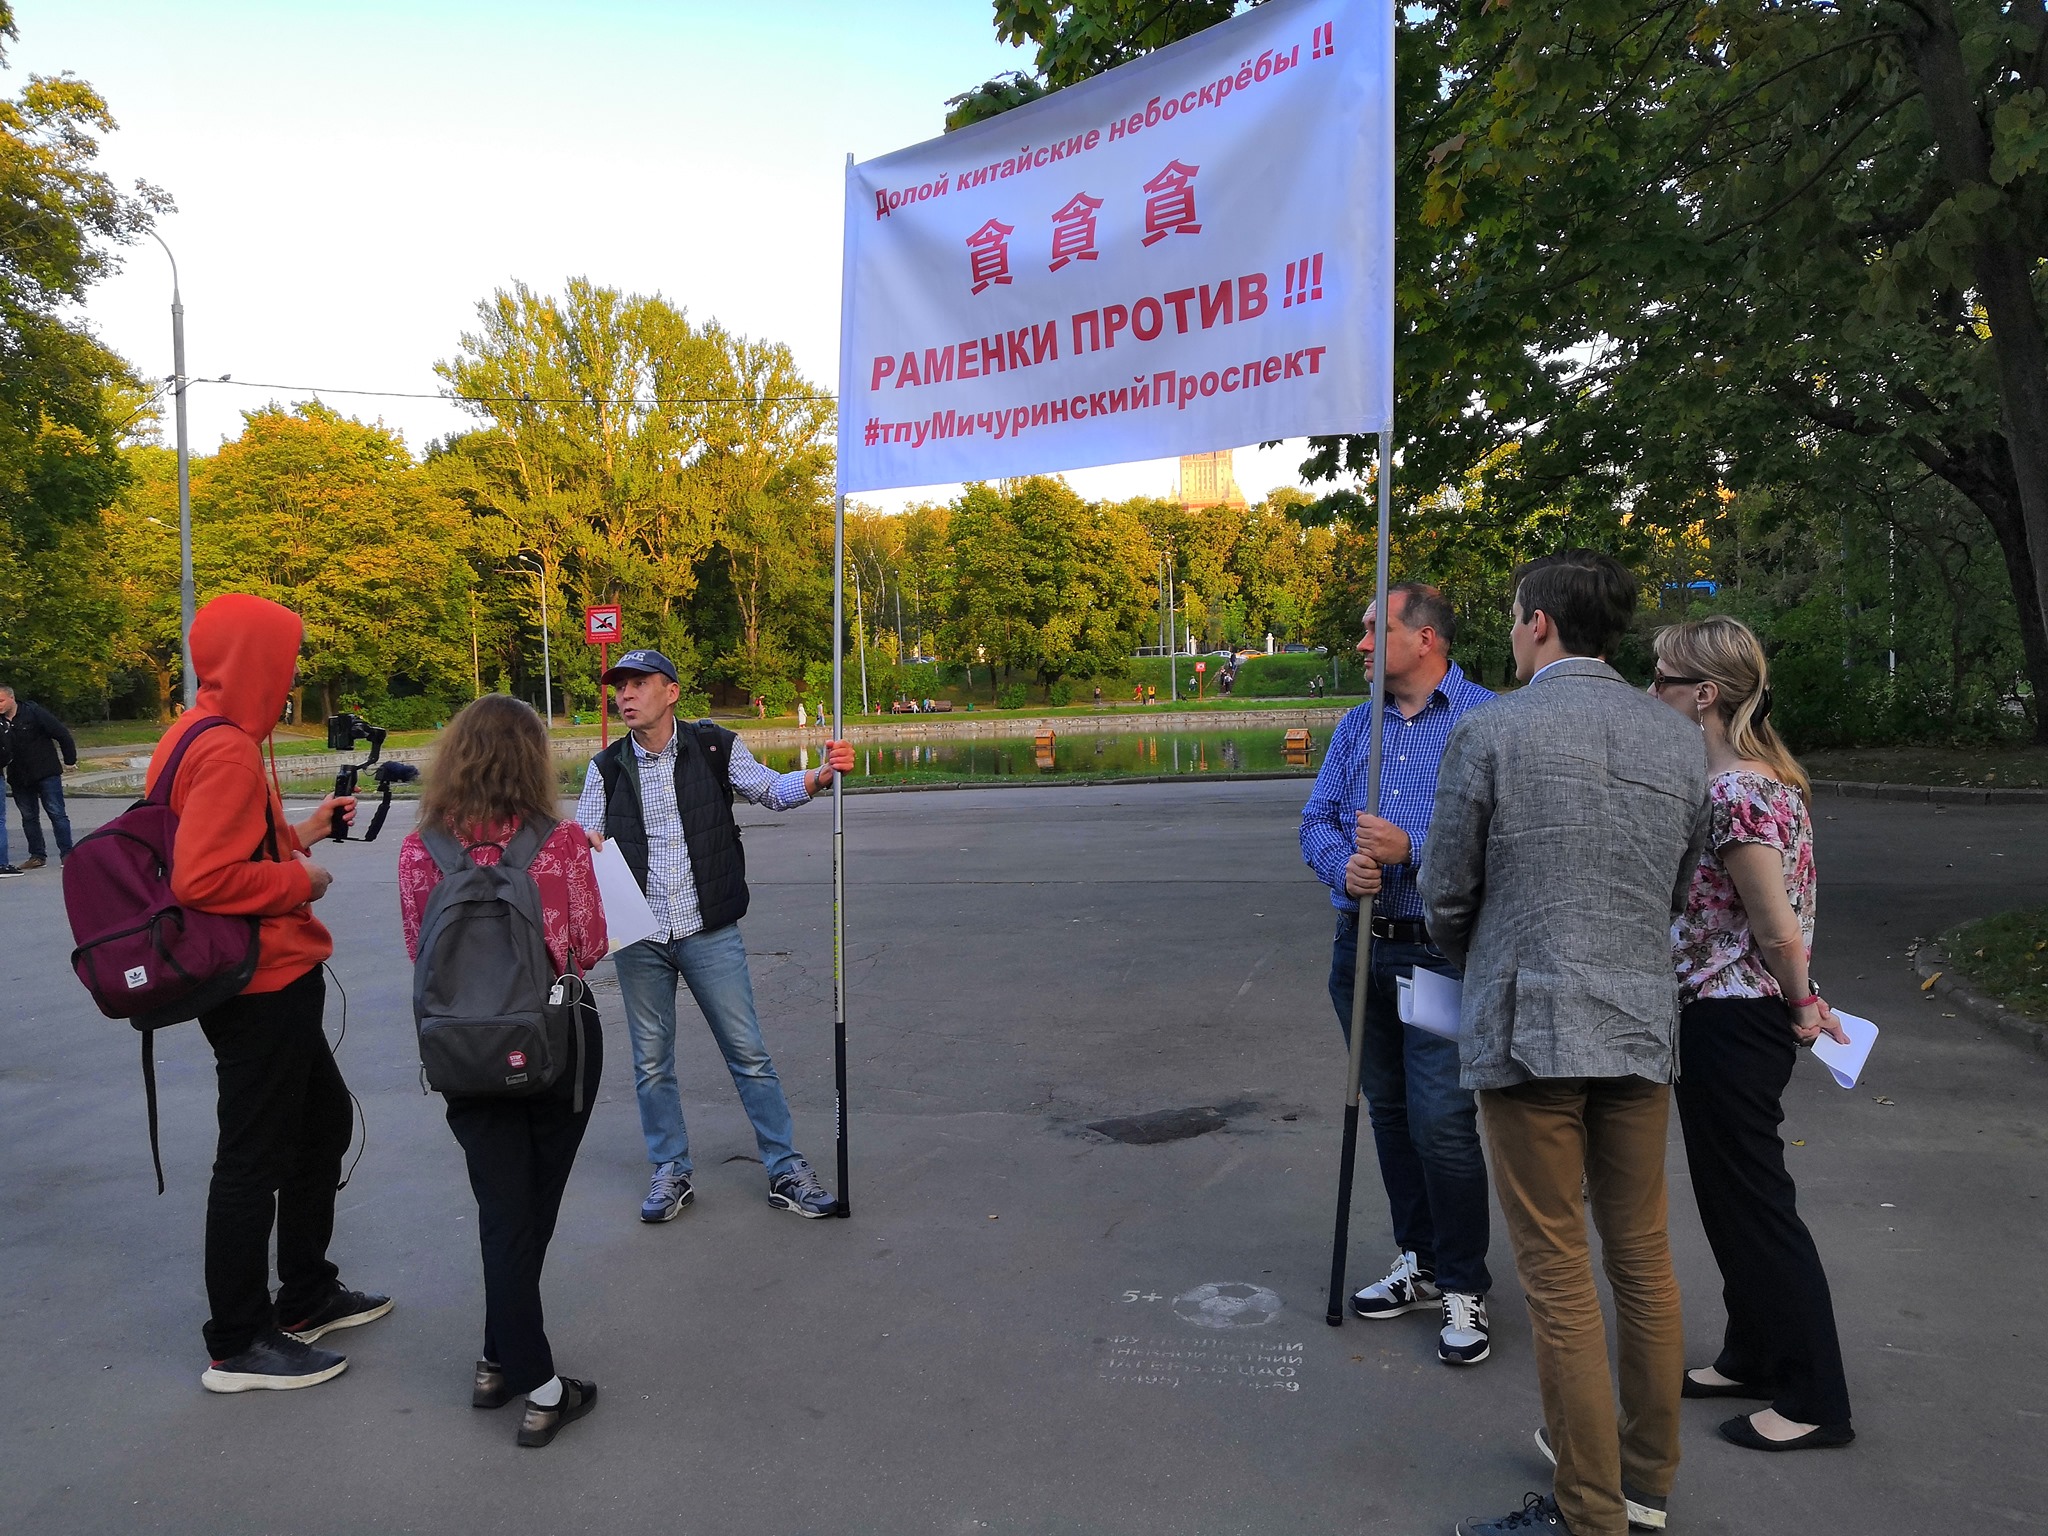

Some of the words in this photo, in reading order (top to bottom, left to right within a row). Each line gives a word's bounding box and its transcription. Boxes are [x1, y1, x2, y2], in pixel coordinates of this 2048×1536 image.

[875, 172, 950, 221] Долой
[956, 128, 1101, 192] китайские
[1107, 43, 1300, 143] небоскрёбы
[870, 319, 1059, 392] РАМЕНКИ
[1072, 272, 1269, 356] ПРОТИВ
[1282, 252, 1325, 309] !!!
[864, 345, 1327, 448] #тпуМичуринскийПроспект
